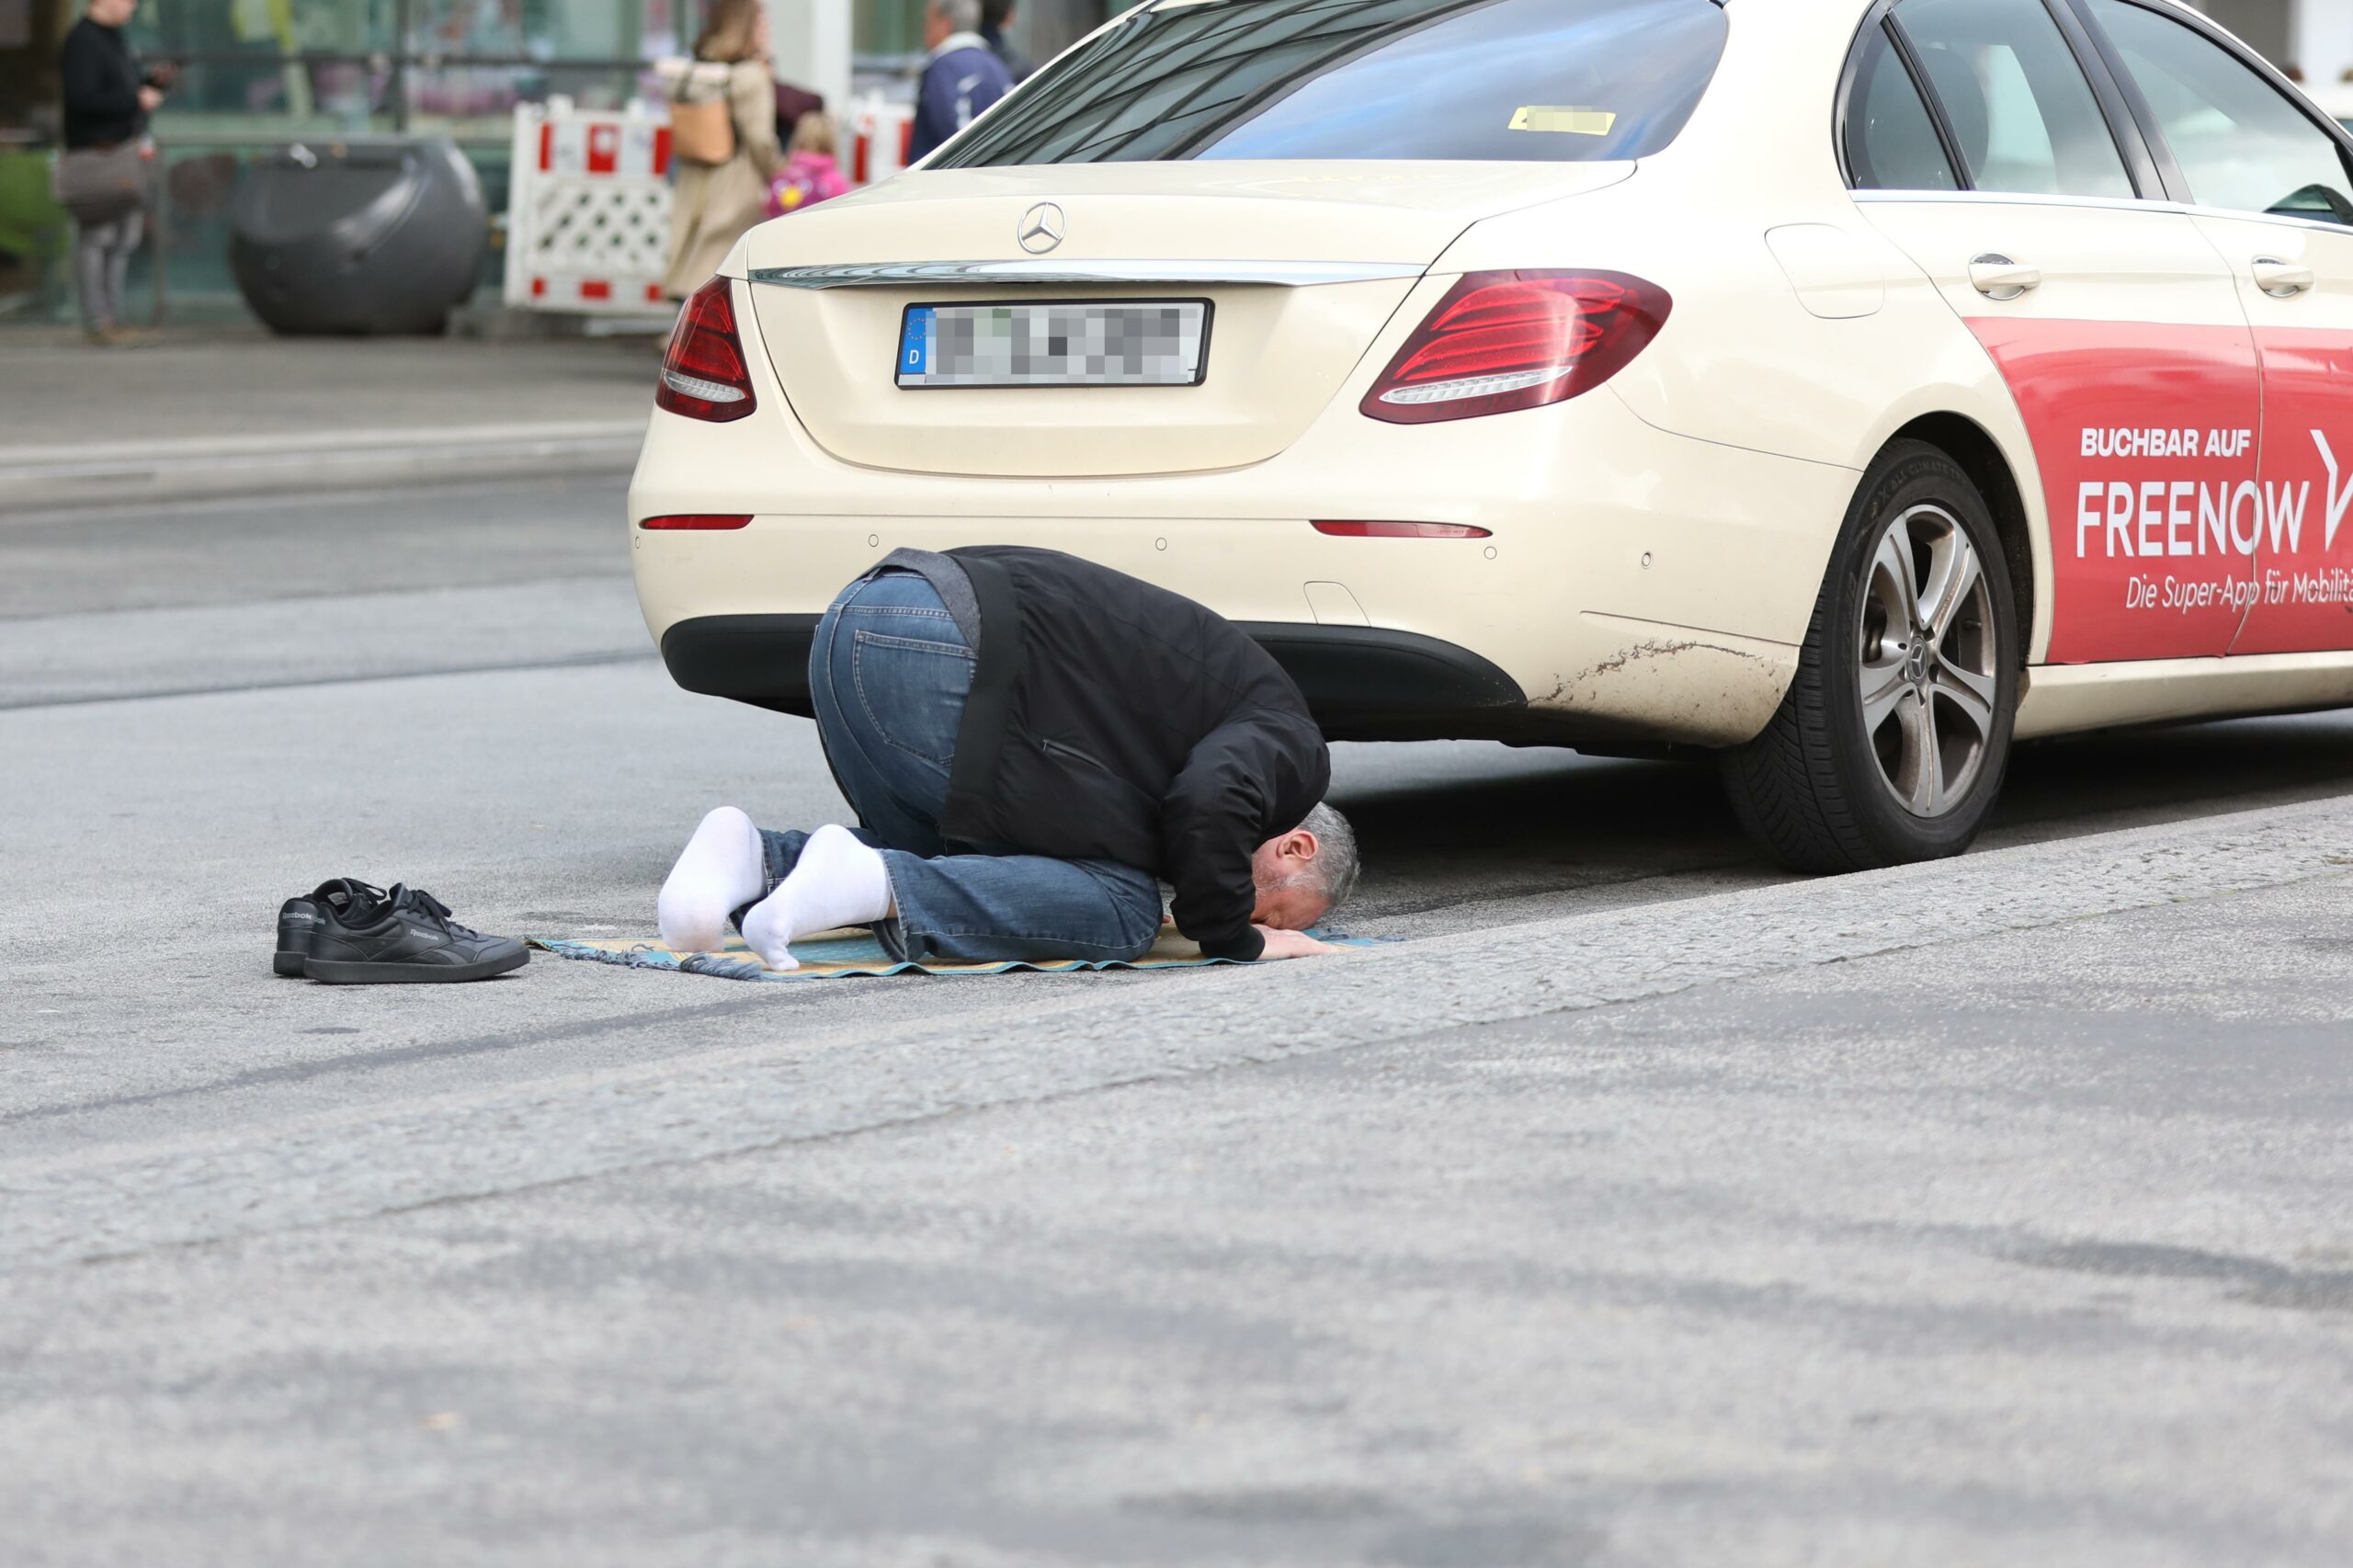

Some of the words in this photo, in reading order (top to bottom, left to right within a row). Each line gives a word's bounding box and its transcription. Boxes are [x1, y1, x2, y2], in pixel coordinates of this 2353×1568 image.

[909, 349, 919, 365] D
[2080, 427, 2200, 457] BUCHBAR
[2204, 428, 2252, 458] AUF
[2076, 480, 2310, 558] FREENOW
[2125, 574, 2158, 608] Die
[2162, 574, 2259, 614] Super-App
[2264, 568, 2289, 604] für
[282, 911, 312, 920] Reebok
